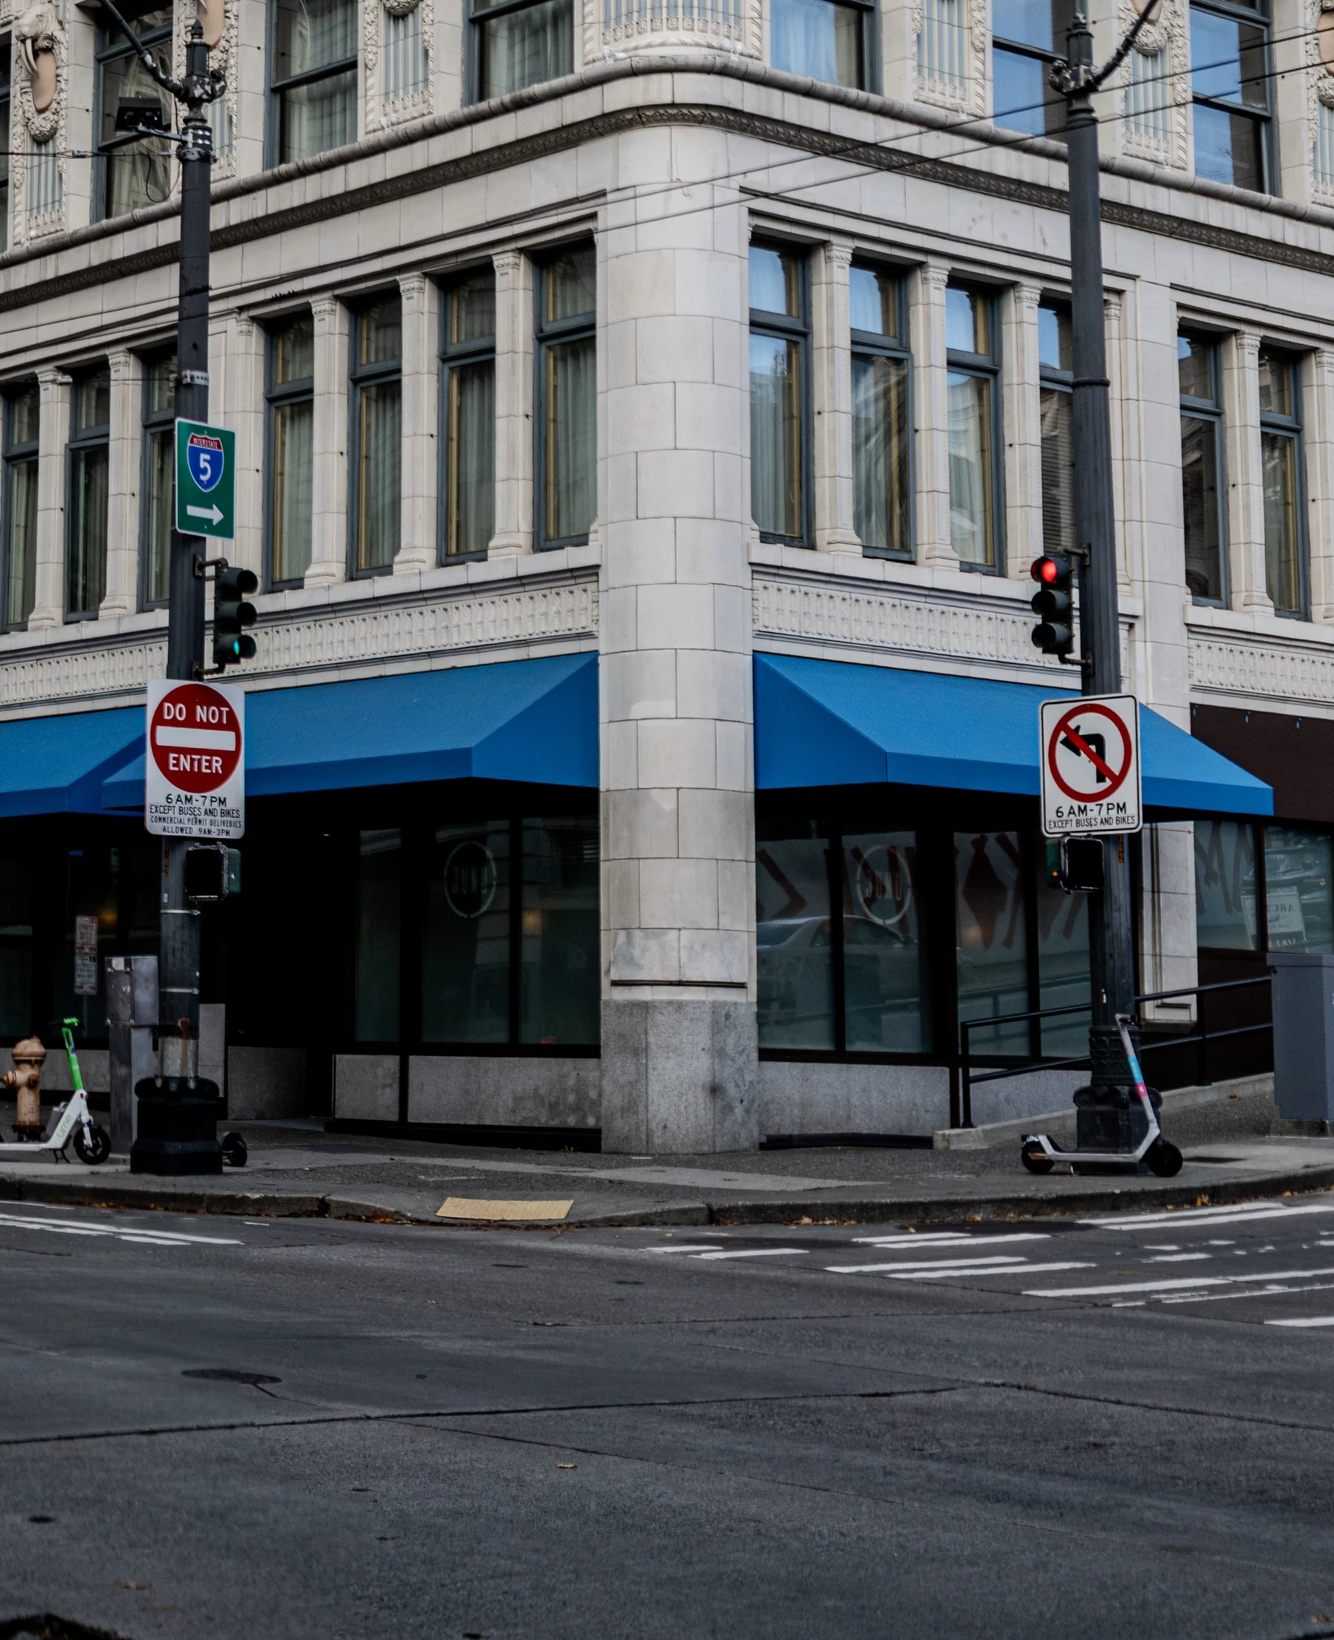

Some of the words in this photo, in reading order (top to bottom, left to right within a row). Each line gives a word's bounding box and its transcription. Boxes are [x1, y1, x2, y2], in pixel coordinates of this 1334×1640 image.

[193, 437, 219, 449] INTERSTATE
[199, 452, 212, 481] 5
[163, 702, 187, 721] DO
[195, 705, 230, 724] NOT
[168, 753, 223, 774] ENTER
[150, 804, 176, 815] EXCEPT
[179, 806, 202, 817] BUSES
[204, 807, 218, 817] AND
[221, 808, 241, 819] BIKES
[150, 815, 186, 825] COMMERCIAL
[187, 817, 208, 826] PERMIT
[210, 818, 242, 829] DELIVERIES
[1048, 819, 1074, 830] EXCEPT
[1076, 817, 1098, 828] BUSES
[1099, 816, 1114, 826] AND
[1115, 815, 1136, 825] BIKES
[162, 825, 194, 834] ALLOWED
[198, 827, 231, 837] 9AM-3PM
